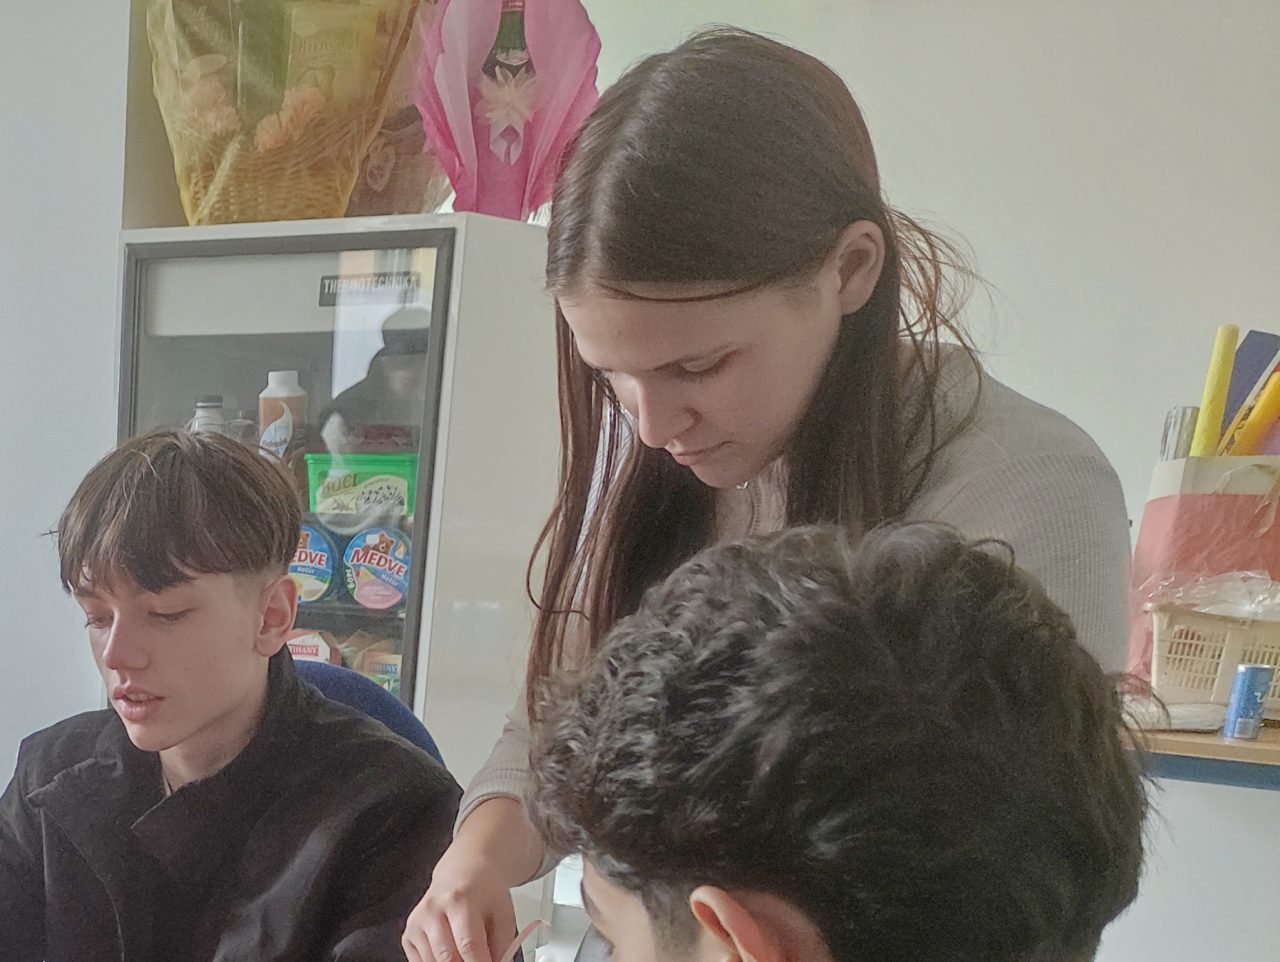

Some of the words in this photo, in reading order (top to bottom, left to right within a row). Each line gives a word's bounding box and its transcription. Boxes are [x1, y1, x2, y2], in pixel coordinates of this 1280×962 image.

[323, 275, 417, 294] THERMOTECHNIKA
[350, 549, 407, 578] MEDVE
[289, 645, 318, 654] TIHANY
